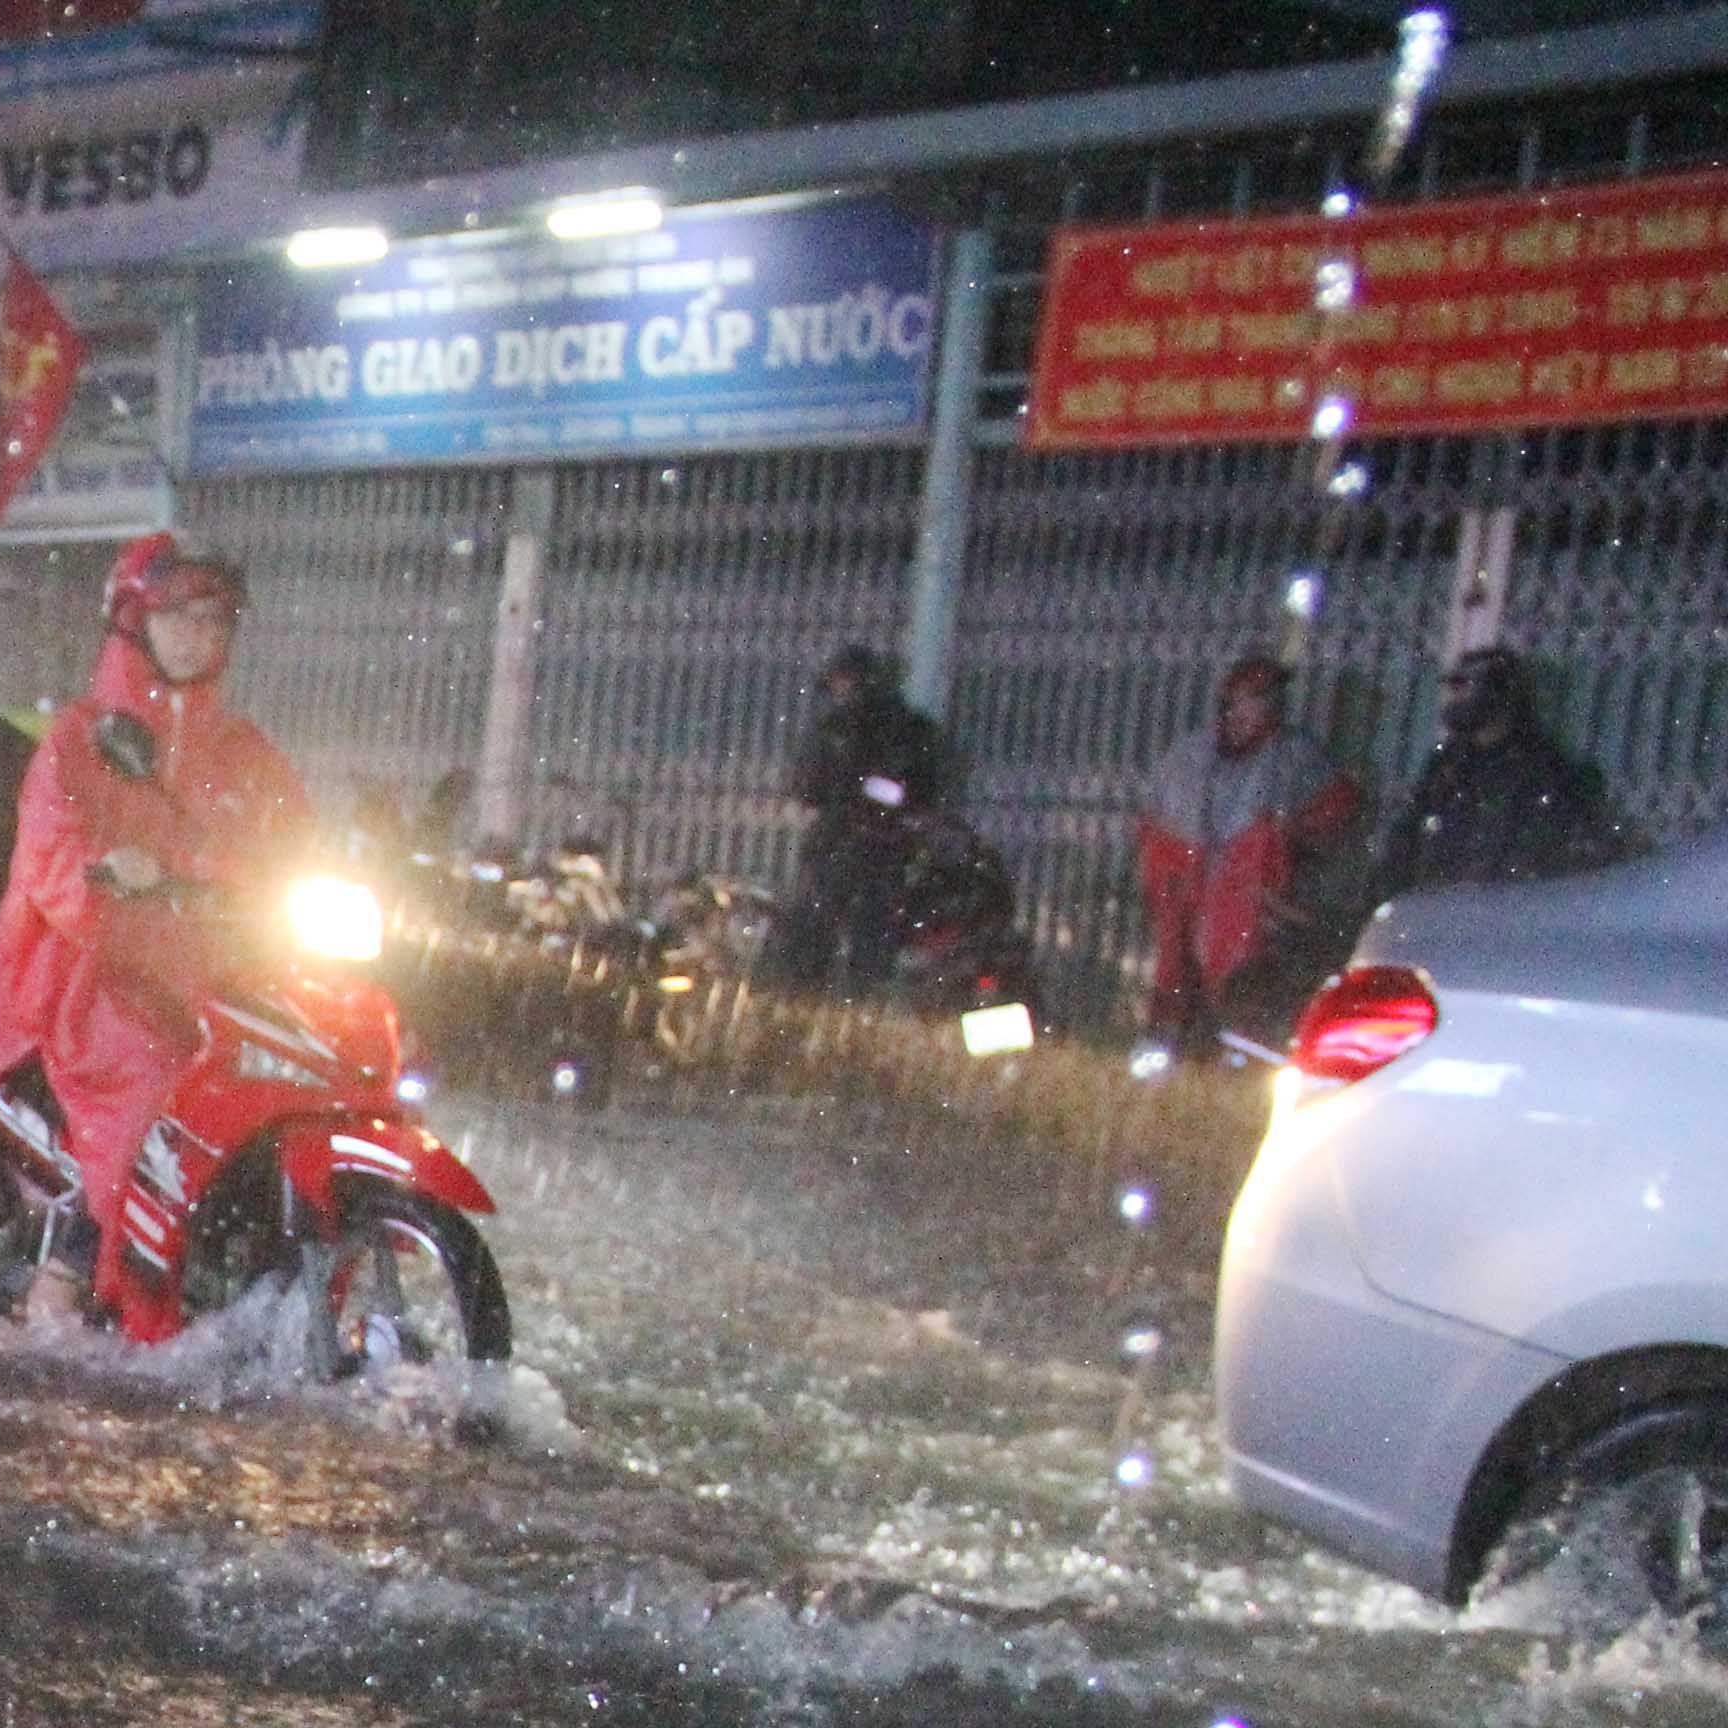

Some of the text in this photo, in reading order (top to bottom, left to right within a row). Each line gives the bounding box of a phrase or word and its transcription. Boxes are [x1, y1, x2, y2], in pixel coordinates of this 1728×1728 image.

[197, 336, 351, 406] PHÒNG
[361, 334, 482, 398] GIAO
[492, 318, 628, 395] DỊCH
[636, 284, 755, 380] CẤP
[762, 281, 935, 372] NƯỚC
